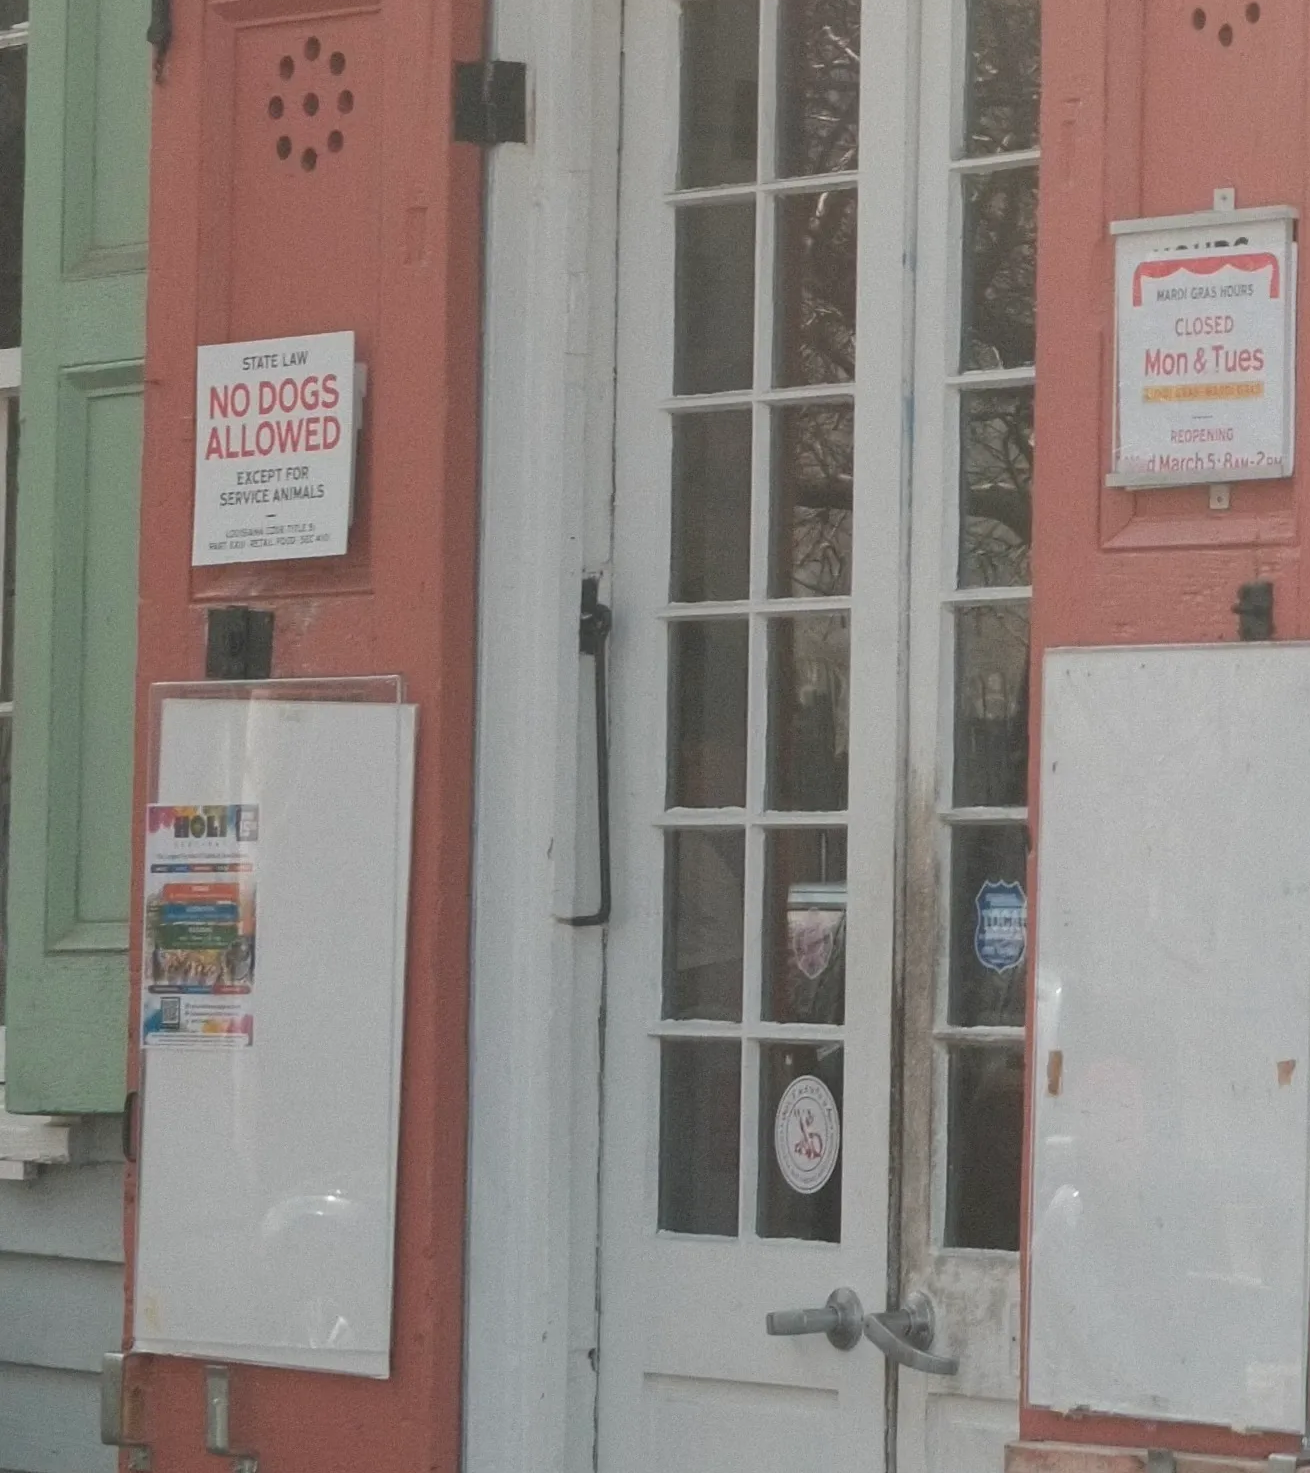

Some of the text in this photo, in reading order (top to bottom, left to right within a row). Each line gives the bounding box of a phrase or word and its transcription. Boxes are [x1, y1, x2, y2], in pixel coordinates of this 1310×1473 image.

[1156, 283, 1255, 303] MARDI GRAS HOURS
[1174, 315, 1235, 338] CLOSED
[242, 351, 309, 372] STATE LAW
[1144, 344, 1265, 377] Mon & Tues
[208, 373, 340, 421] NO DOGS
[205, 415, 341, 461] ALLOWED
[1170, 427, 1235, 444] REOPENING
[1158, 452, 1205, 475] March
[236, 465, 310, 486] EXCEPT FOR
[219, 484, 325, 508] SERVICE ANIMALS
